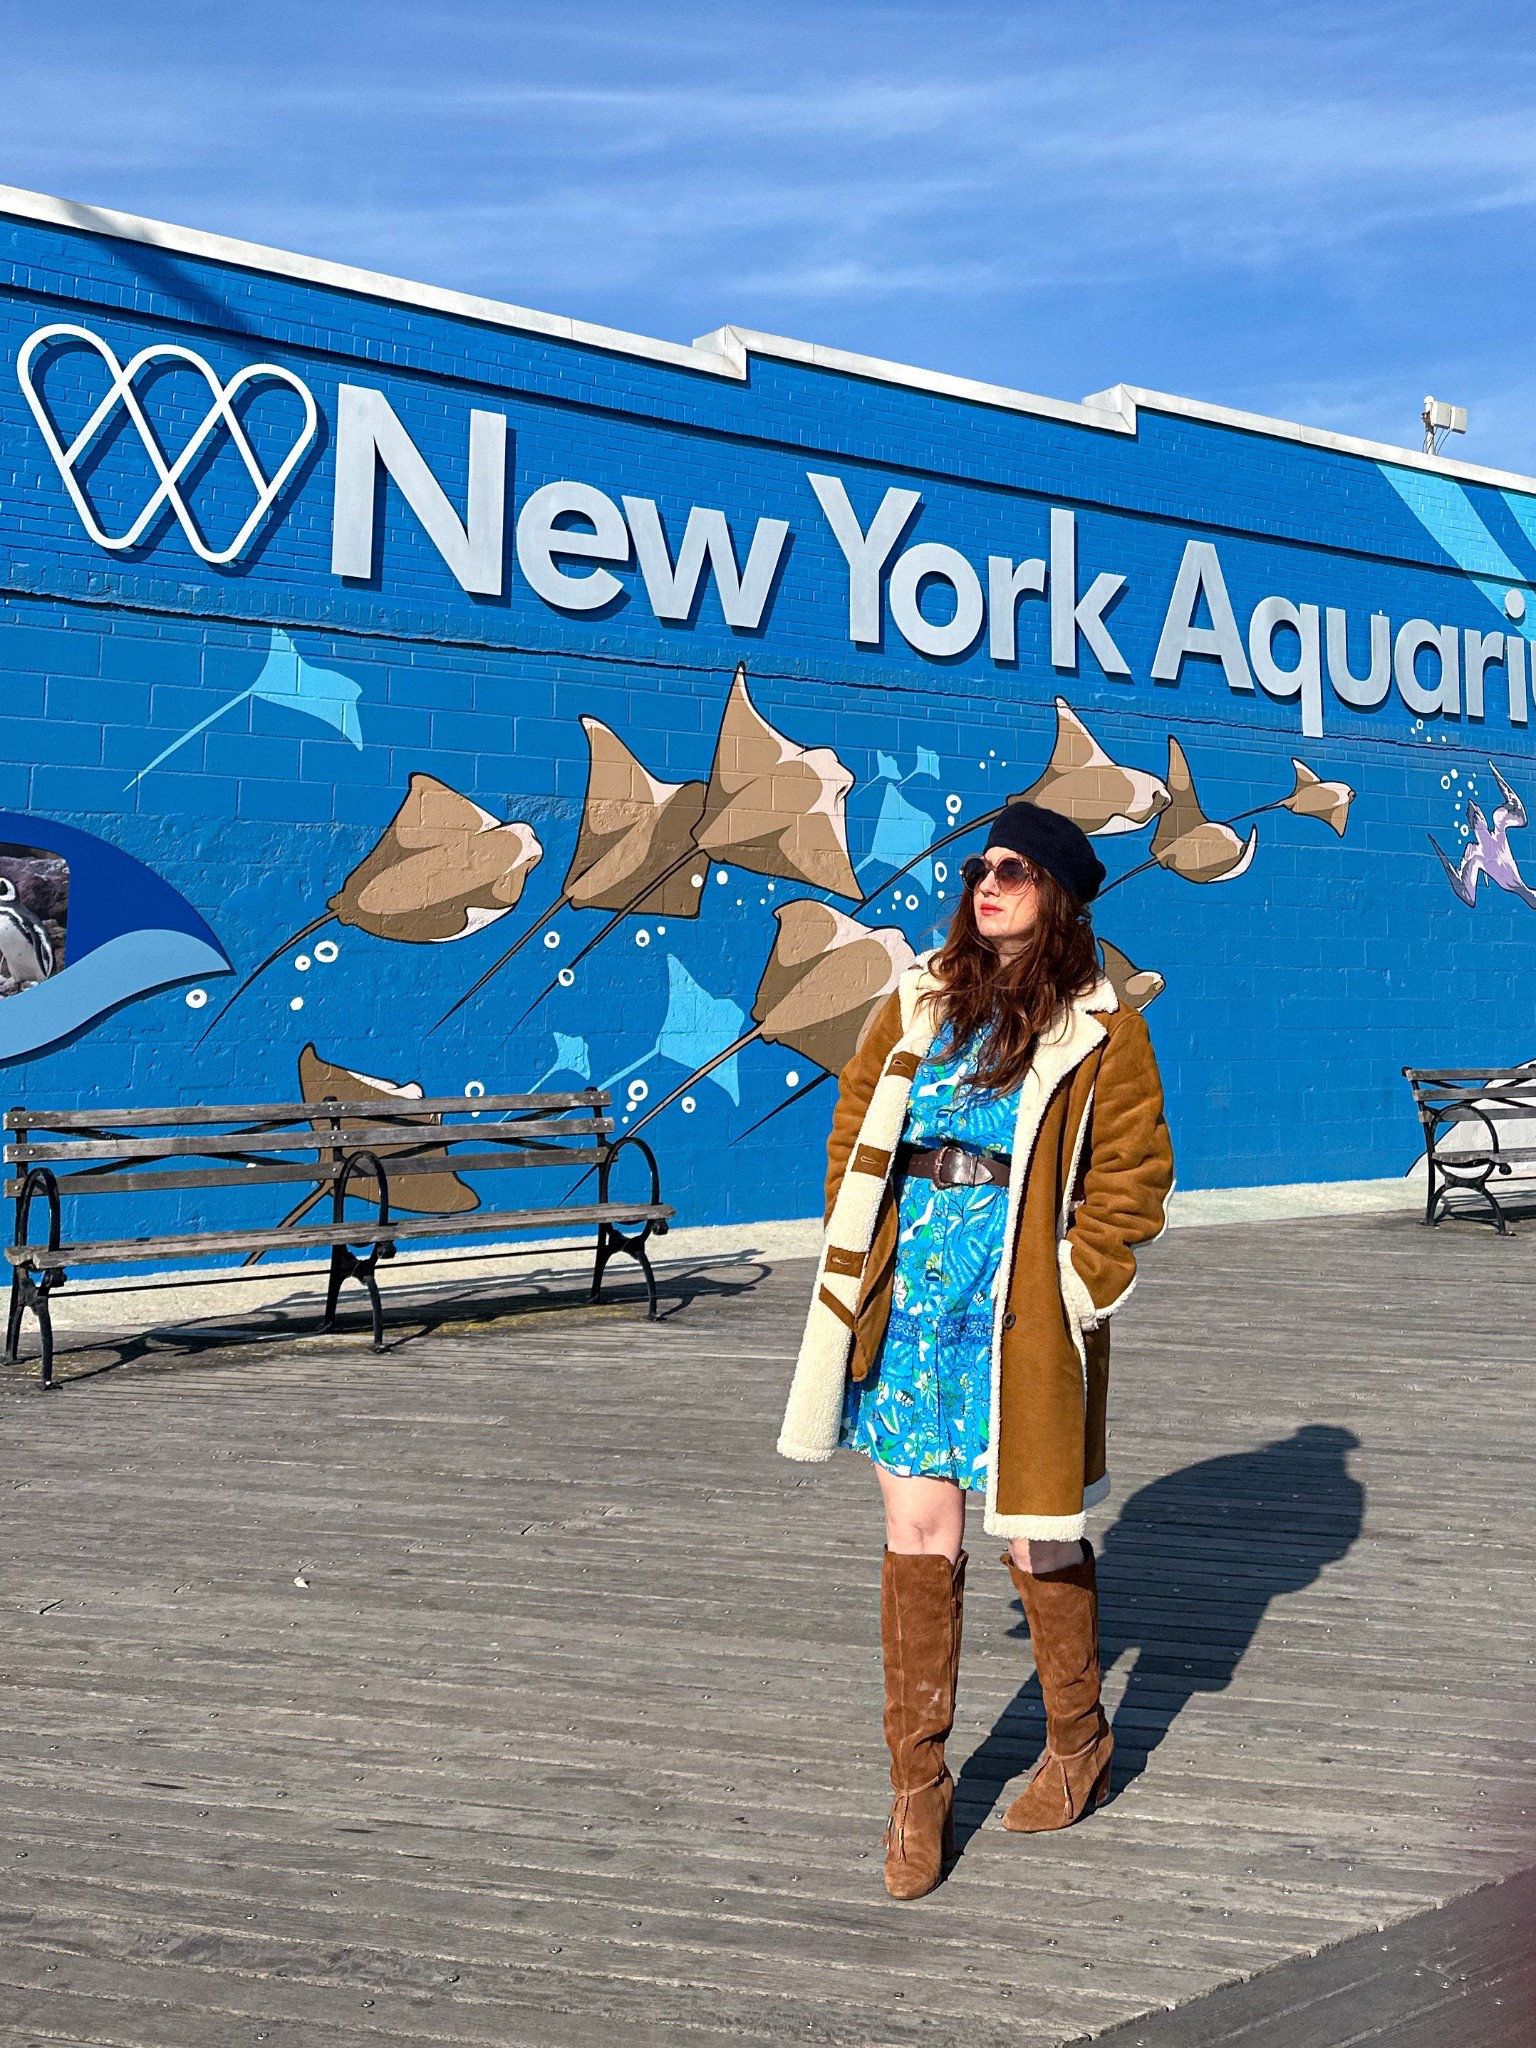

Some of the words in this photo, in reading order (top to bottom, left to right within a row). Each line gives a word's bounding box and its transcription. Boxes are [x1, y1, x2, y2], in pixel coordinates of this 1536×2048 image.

[331, 383, 790, 628] New
[806, 472, 1132, 676] York
[1150, 539, 1536, 738] Aquari
